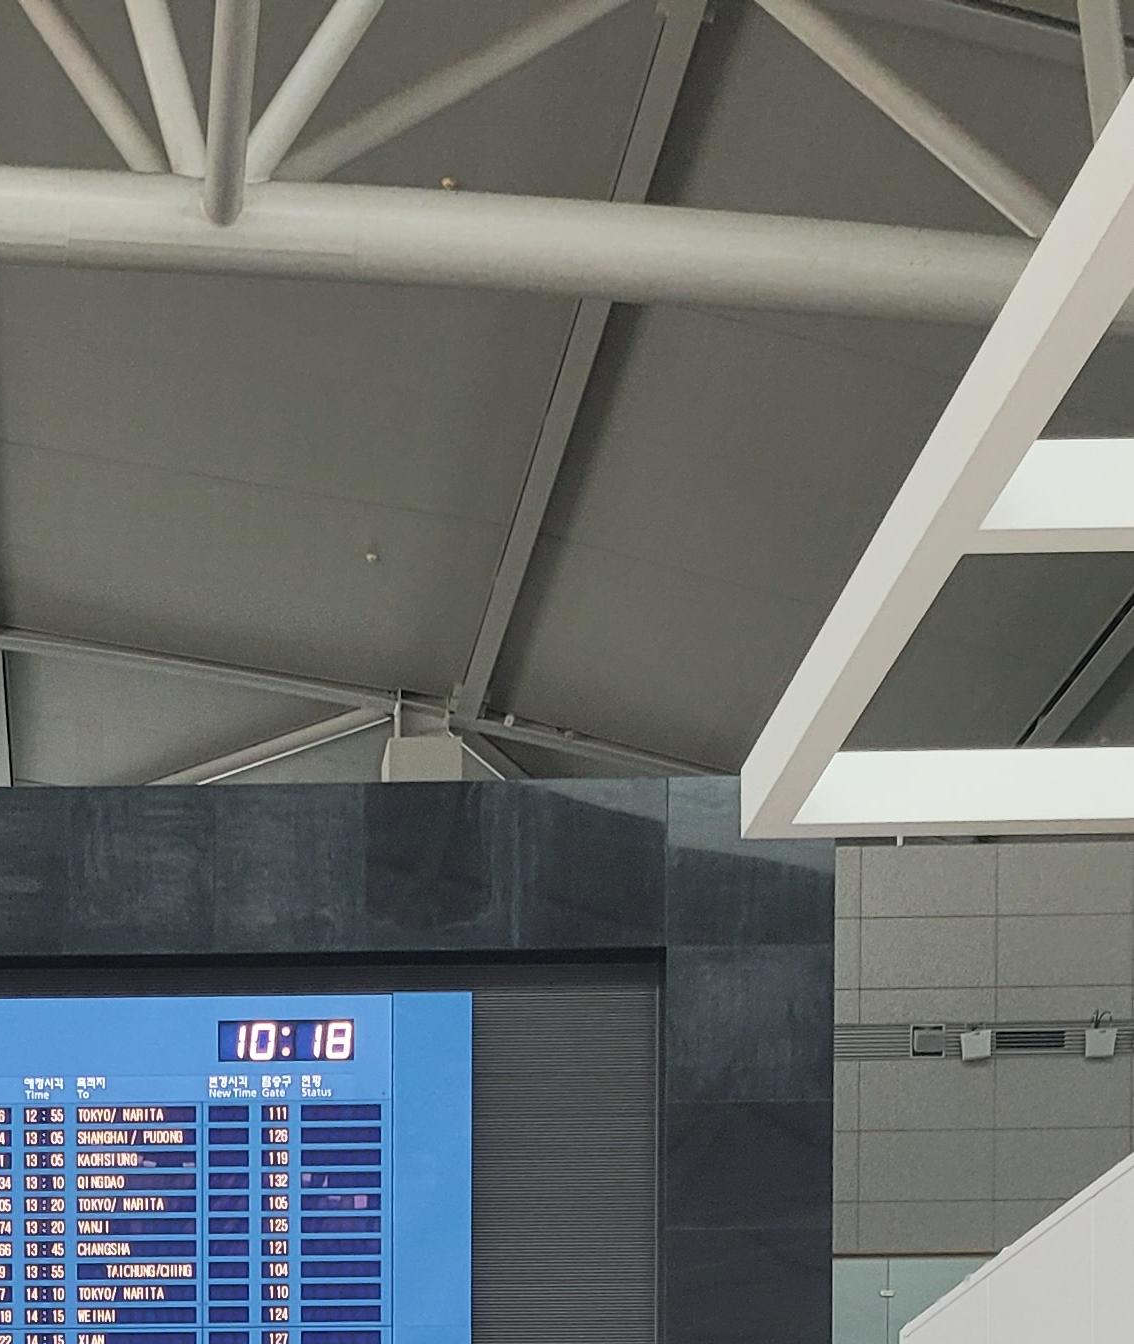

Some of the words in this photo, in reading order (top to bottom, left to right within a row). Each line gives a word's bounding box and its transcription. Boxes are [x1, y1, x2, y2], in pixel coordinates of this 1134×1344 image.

[24, 1089, 50, 1101] Time
[76, 1089, 90, 1100] To
[208, 1088, 232, 1099] New
[232, 1088, 258, 1099] Time
[261, 1087, 286, 1098] Gate
[301, 1087, 333, 1098] Status
[78, 1107, 117, 1123] TOKYO/
[122, 1107, 164, 1122] NARITA
[269, 1106, 287, 1121] 111
[77, 1130, 137, 1145] SHANGHAI/
[142, 1130, 184, 1144] PUDONG
[268, 1128, 289, 1143] 126
[77, 1152, 138, 1167] KAOHSIUNG
[269, 1151, 289, 1165] 119
[77, 1175, 125, 1190] QINGDAO
[269, 1173, 289, 1188] 132
[78, 1197, 117, 1213] TOKYO/
[122, 1197, 165, 1211] NARITA
[269, 1196, 289, 1210] 105
[77, 1220, 109, 1234] YANJI
[269, 1218, 289, 1232] 125
[77, 1242, 131, 1257] CHANGSHA
[269, 1240, 287, 1255] 121
[269, 1263, 289, 1277] 104
[78, 1287, 117, 1301] TOKYO/
[123, 1286, 165, 1300] NARITA
[269, 1285, 289, 1299] 110
[77, 1309, 116, 1323] WEIHAI
[269, 1307, 289, 1321] 124
